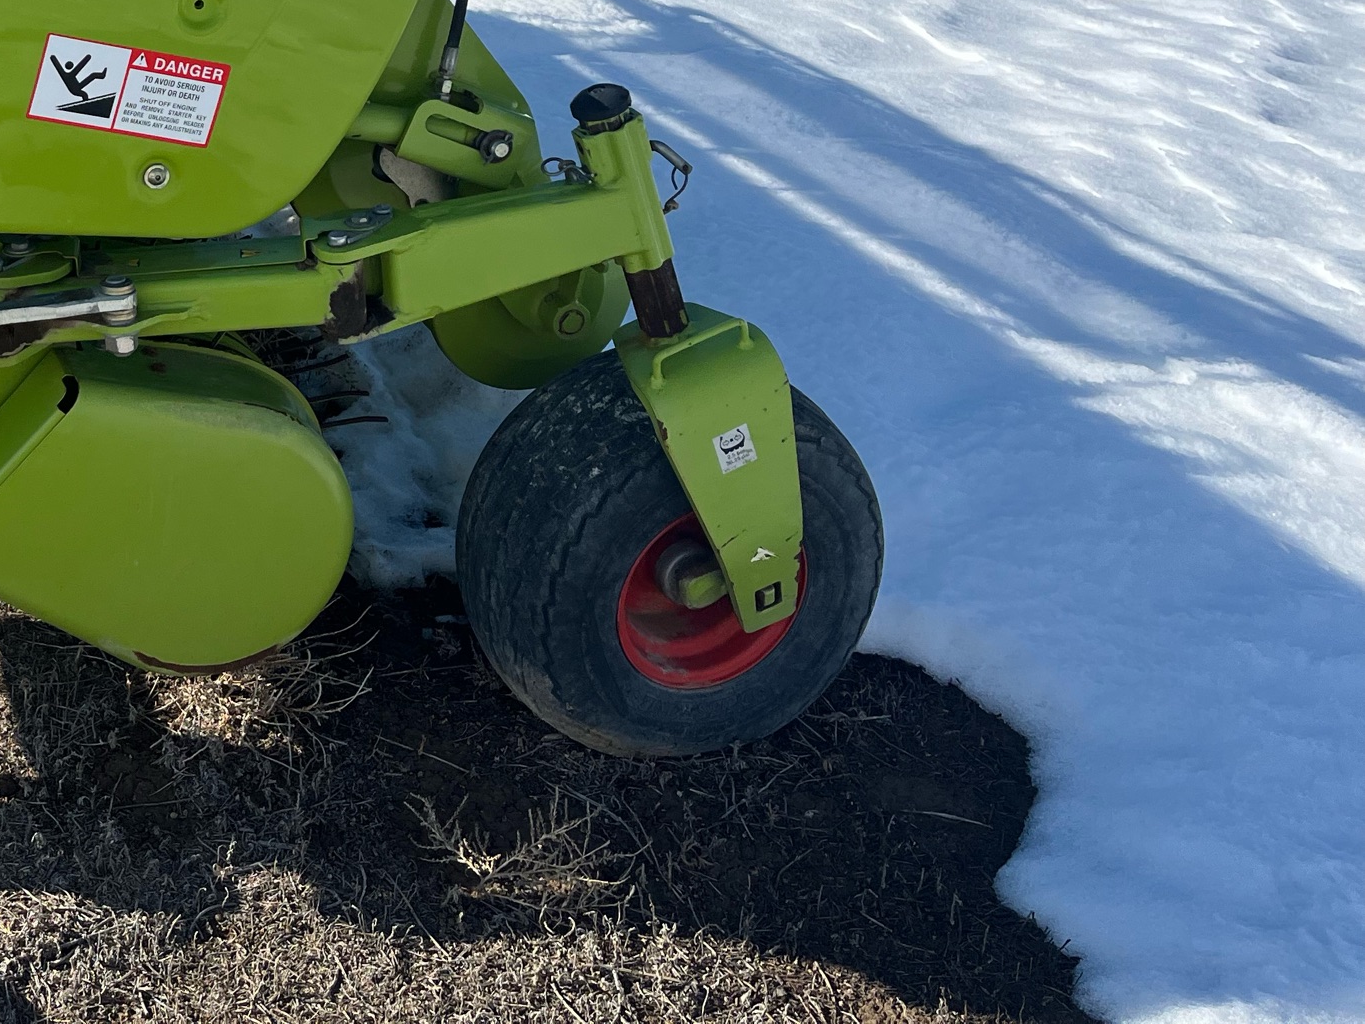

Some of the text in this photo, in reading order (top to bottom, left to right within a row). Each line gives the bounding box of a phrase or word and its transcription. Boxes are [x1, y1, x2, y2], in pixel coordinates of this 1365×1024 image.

[154, 58, 224, 81] DANGER
[142, 85, 166, 95] INJURY
[179, 91, 200, 101] DEATH
[155, 78, 175, 87] AVOID
[177, 82, 206, 93] SERIOUS
[139, 97, 157, 105] SHUT
[172, 103, 197, 112] ENGINE
[141, 105, 164, 114] REMOVE
[168, 110, 192, 119] STARTER
[123, 110, 144, 118] BEFORE
[183, 120, 204, 128] HEADER
[130, 118, 151, 127] MAKING
[164, 124, 203, 136] ADJUSTMENTS
